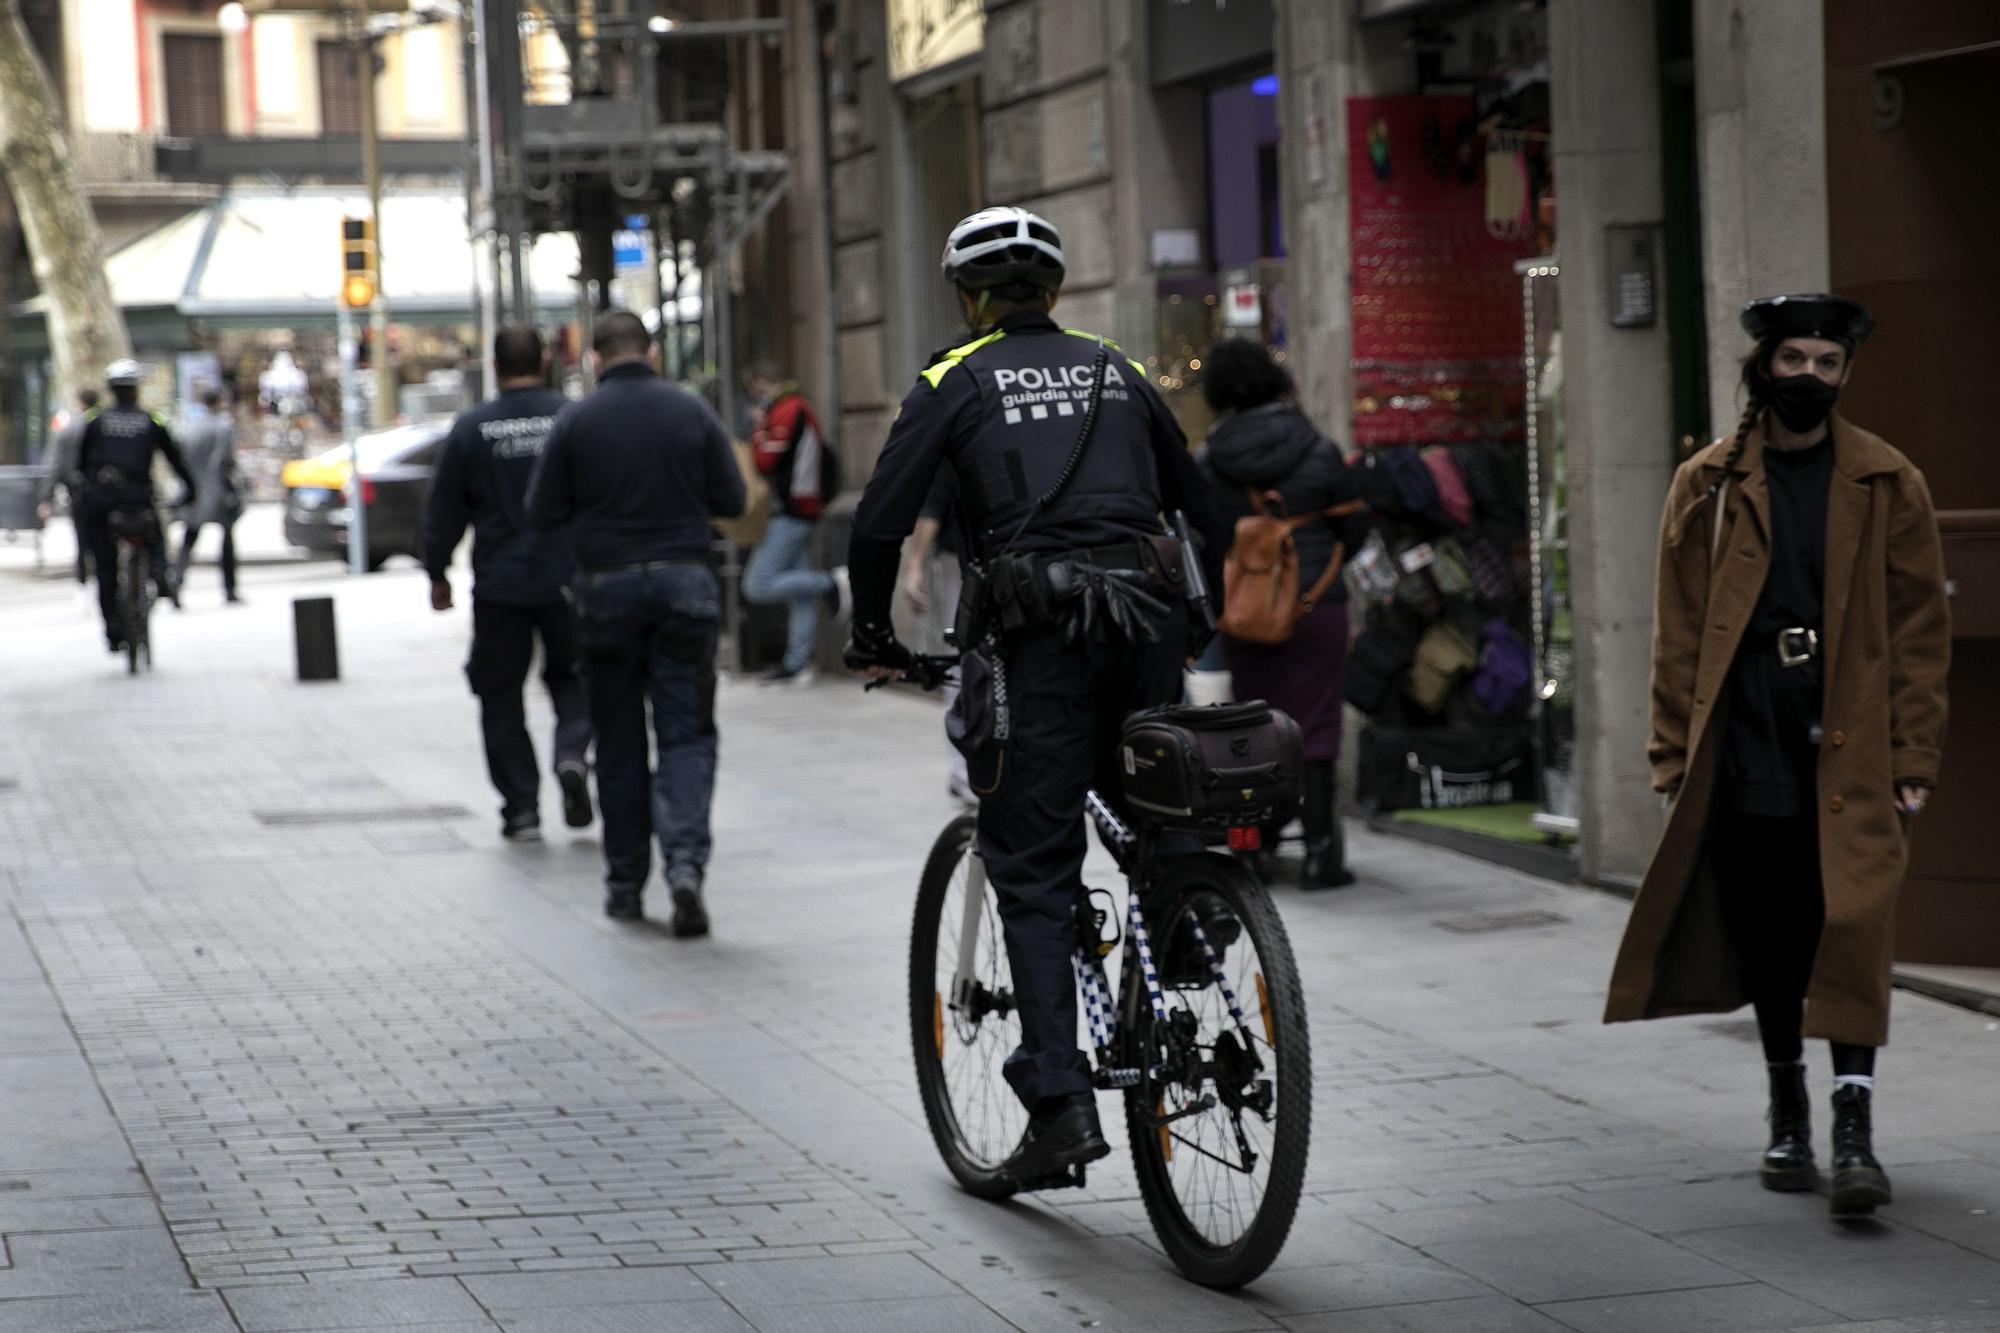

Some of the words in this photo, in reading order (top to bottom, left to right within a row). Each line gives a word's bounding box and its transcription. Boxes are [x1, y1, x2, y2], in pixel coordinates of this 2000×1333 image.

[1872, 76, 1904, 129] 9
[994, 364, 1126, 391] POLICA
[1072, 386, 1129, 400] urana
